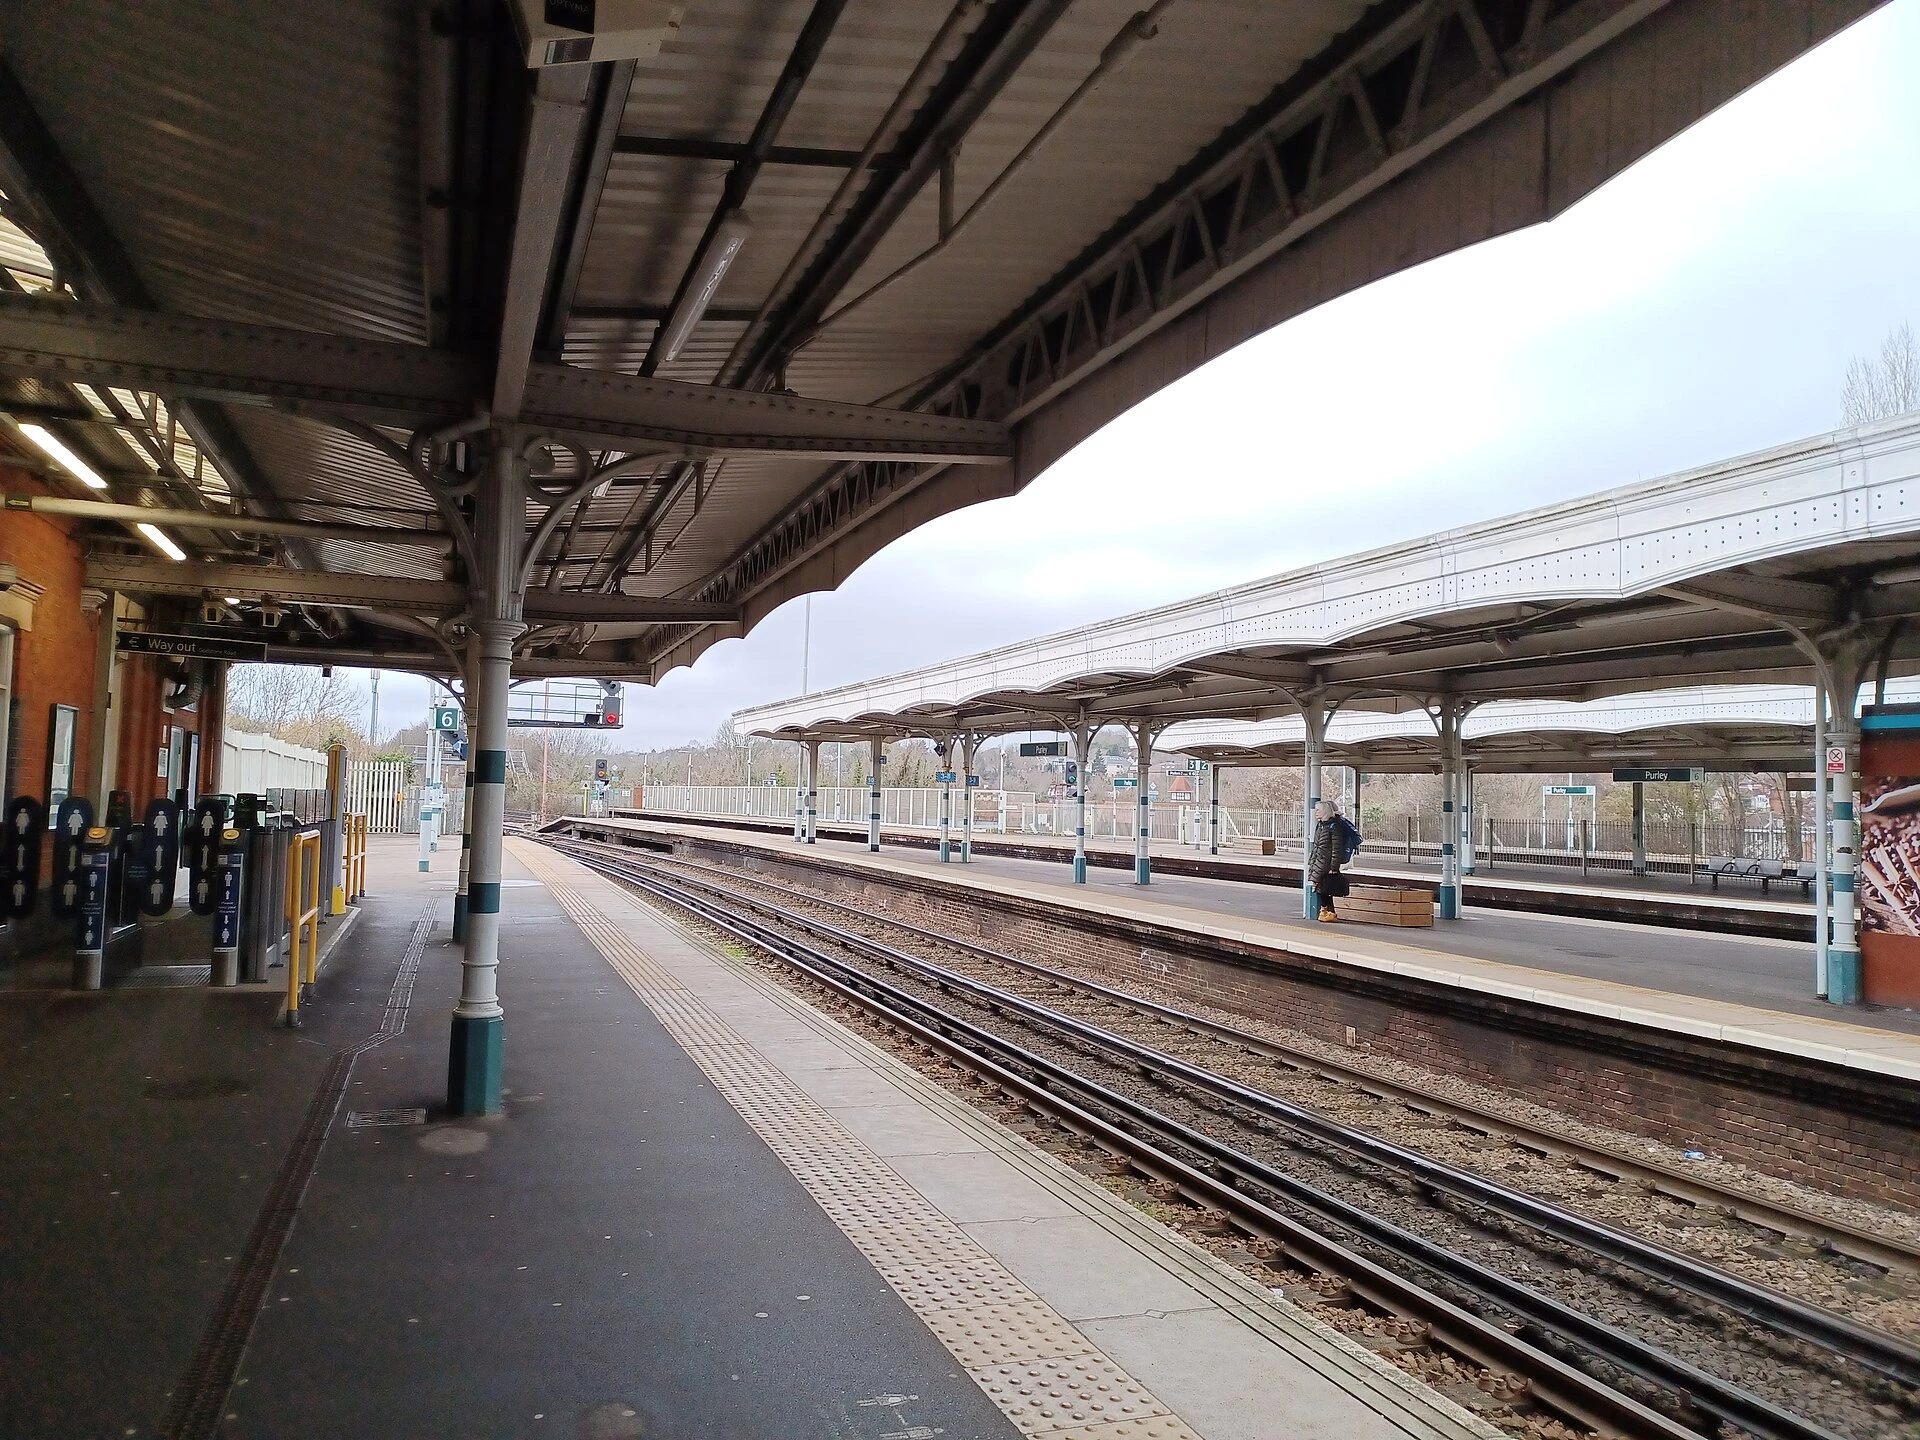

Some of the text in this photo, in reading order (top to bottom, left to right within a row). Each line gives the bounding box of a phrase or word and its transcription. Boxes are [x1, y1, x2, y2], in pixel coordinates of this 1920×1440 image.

[149, 638, 175, 652] Way
[176, 643, 196, 652] out
[441, 711, 453, 727] 6
[1189, 760, 1195, 769] 3
[1201, 760, 1207, 769] 2
[1645, 771, 1669, 781] Purley
[1694, 772, 1700, 780] 6
